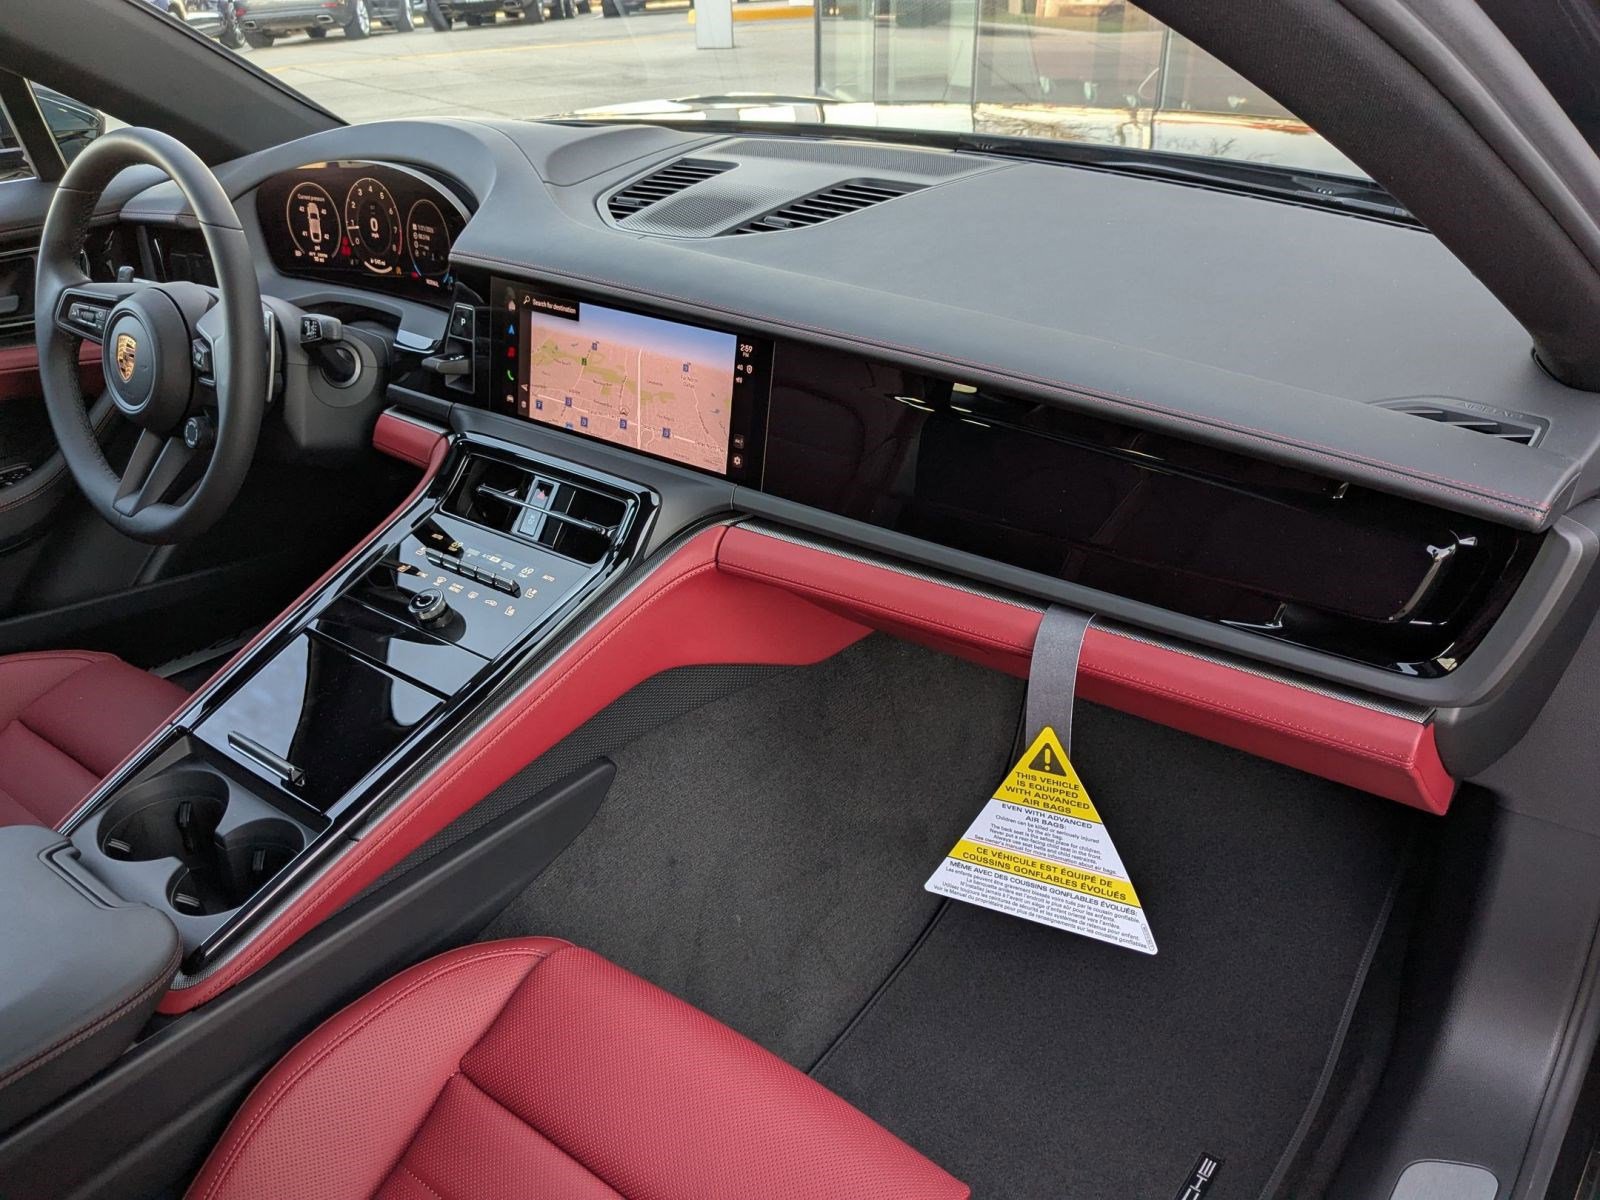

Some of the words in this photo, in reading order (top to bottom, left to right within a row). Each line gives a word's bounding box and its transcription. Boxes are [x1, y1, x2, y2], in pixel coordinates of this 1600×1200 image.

[370, 217, 378, 232] 0
[533, 298, 546, 308] Search
[553, 304, 578, 314] destination
[740, 344, 753, 353] 2:59
[1015, 771, 1036, 781] THIS
[1039, 776, 1079, 790] VEHICLE
[1029, 782, 1078, 799] EQUIPPED
[1005, 785, 1030, 796] WITH
[1033, 791, 1089, 810] ADVANCED
[1022, 797, 1039, 806] AIR
[1042, 801, 1071, 814] BAGS
[1002, 803, 1022, 812] EVEN
[1024, 808, 1045, 818] WITH
[1047, 813, 1092, 829] ADVANCED
[993, 834, 1011, 843] Always
[995, 814, 1016, 823] Children
[1056, 829, 1079, 839] seriously
[1080, 834, 1099, 844] injured
[984, 837, 1003, 845] owner's
[1005, 842, 1023, 850] manual
[1047, 852, 1076, 863] information
[1018, 835, 1045, 846] rear-facing
[962, 851, 1010, 870] COUSSINS
[1013, 864, 1077, 887] GONFLABLES
[1080, 881, 1126, 900] ÉVOLUÉS
[976, 846, 988, 855] CE
[990, 849, 1036, 868] VÉHICULE
[1039, 862, 1058, 873] EST
[1060, 866, 1096, 883] ÉQUIPÉ
[1099, 877, 1112, 887] DE
[950, 859, 972, 871] MÊME
[973, 867, 992, 877] AVEC
[994, 872, 1008, 881] DES
[1009, 876, 1047, 891] COUSSINS
[1049, 887, 1098, 905] GONFLABLES
[955, 869, 972, 877] enfants
[973, 874, 992, 883] peuvent
[1004, 883, 1030, 894] gravement
[1031, 889, 1050, 898] blessés
[1093, 906, 1113, 915] coussin
